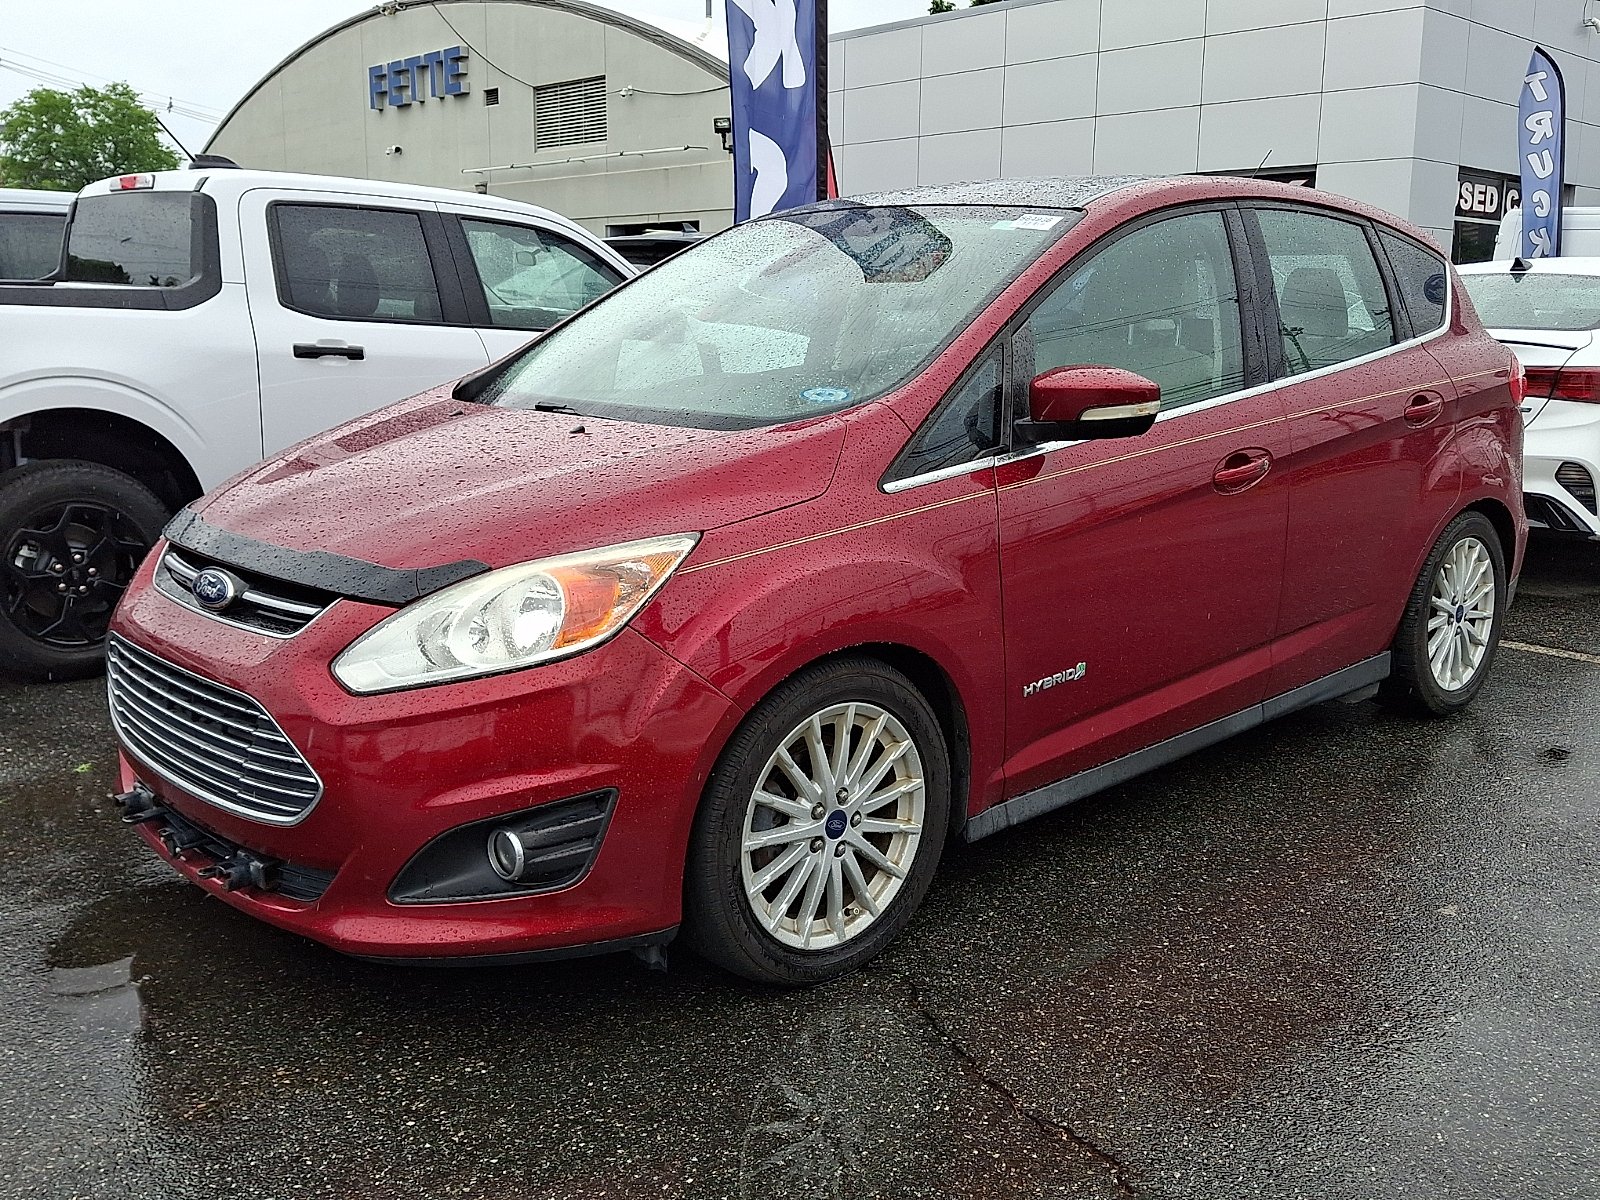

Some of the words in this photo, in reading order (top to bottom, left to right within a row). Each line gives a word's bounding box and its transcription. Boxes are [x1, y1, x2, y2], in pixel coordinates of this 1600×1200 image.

[367, 45, 470, 112] FETTE
[1459, 181, 1499, 213] SED
[196, 574, 221, 599] Ford
[1023, 668, 1076, 698] HYBRID
